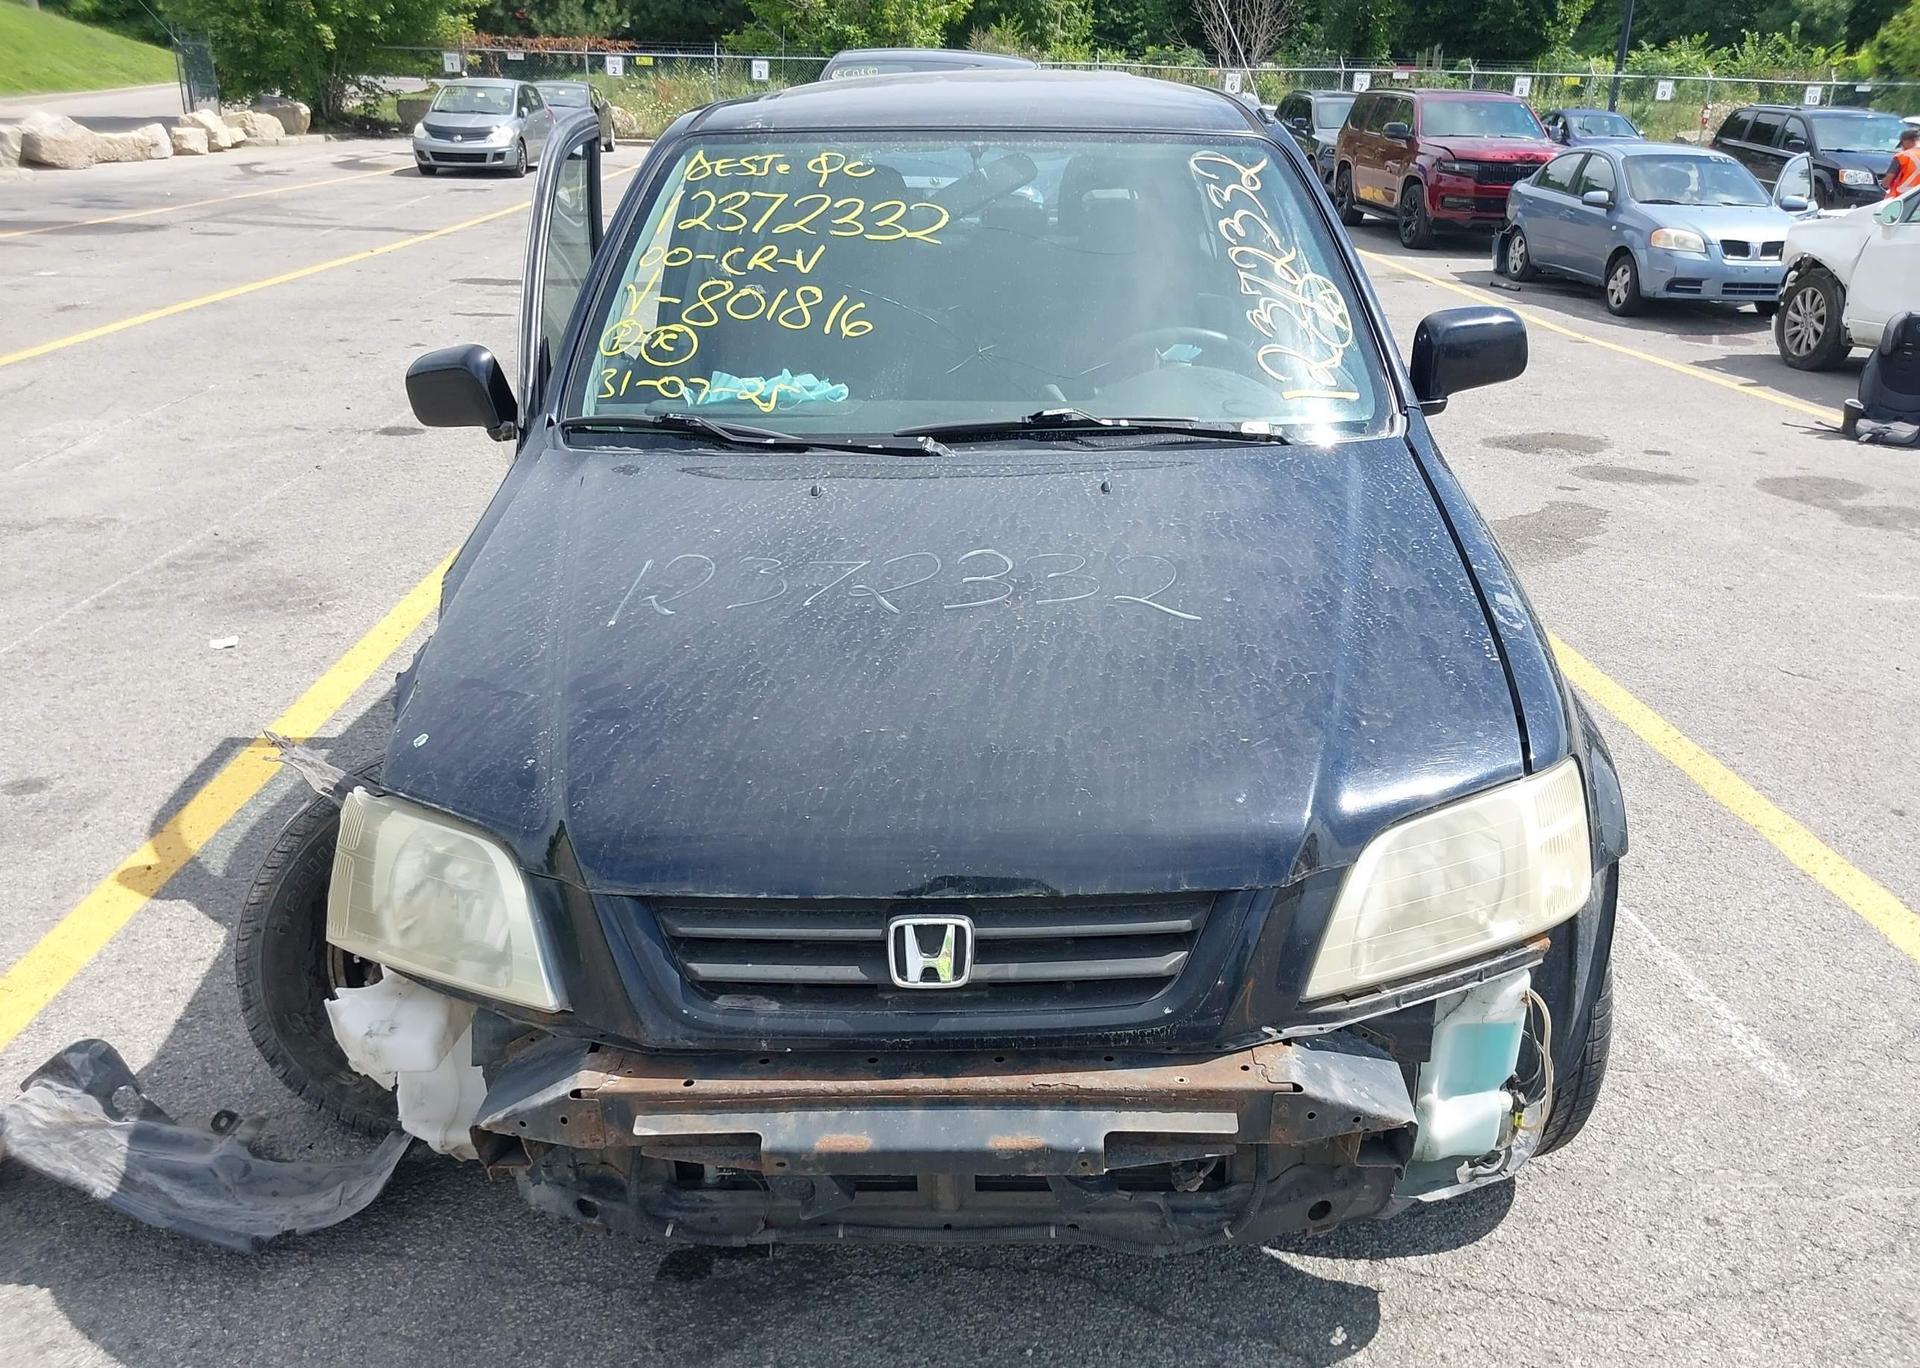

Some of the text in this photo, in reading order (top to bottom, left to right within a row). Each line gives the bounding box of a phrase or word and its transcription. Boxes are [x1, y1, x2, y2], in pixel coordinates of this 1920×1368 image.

[1808, 95, 1818, 103] 10
[657, 190, 951, 245] 12372332
[627, 272, 875, 339] V-801816
[1189, 150, 1361, 401] 12372332
[605, 549, 1204, 626] 12372332
